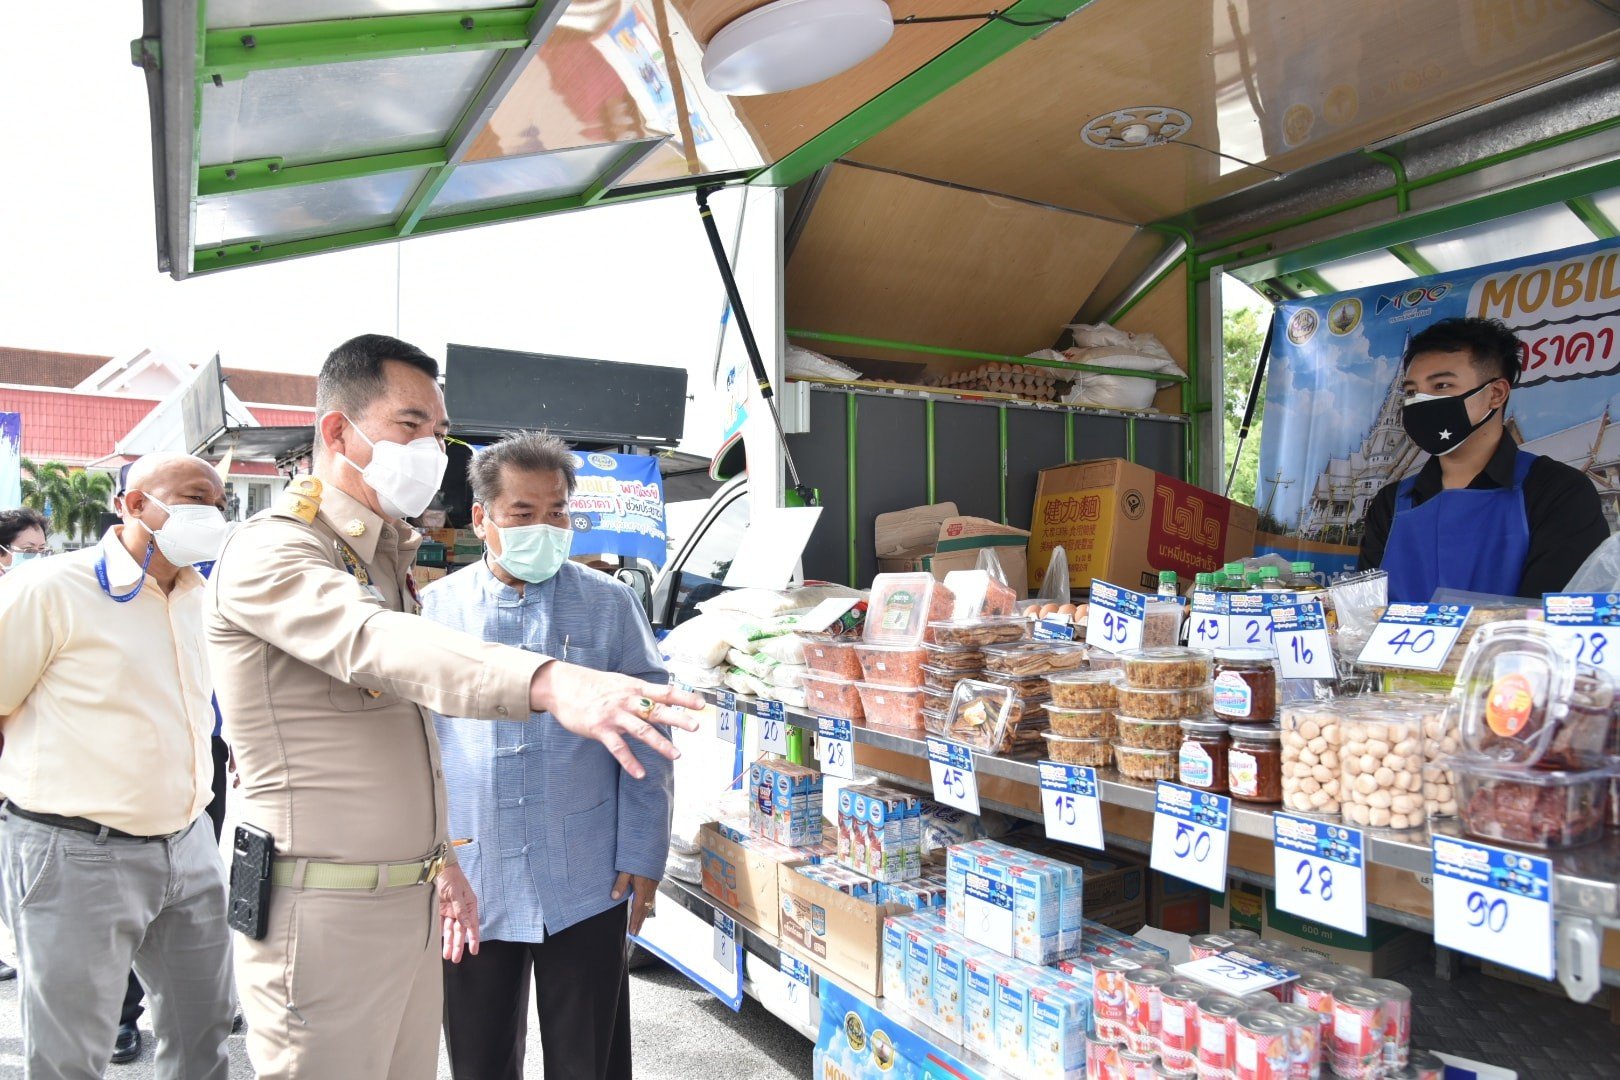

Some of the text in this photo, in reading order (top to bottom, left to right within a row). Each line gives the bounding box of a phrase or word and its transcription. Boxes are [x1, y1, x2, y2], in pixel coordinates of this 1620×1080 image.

[1103, 612, 1128, 644] 95
[1196, 619, 1219, 641] 43
[1387, 627, 1435, 655] 40
[1291, 635, 1313, 665] 16
[763, 720, 779, 741] 20
[827, 742, 845, 767] 28
[943, 768, 966, 799] 45
[1055, 795, 1077, 826] 15
[1173, 821, 1211, 862] 50
[1296, 859, 1333, 901] 28
[1467, 891, 1508, 933] 90
[1302, 924, 1319, 936] 600
[1206, 964, 1258, 980] 25
